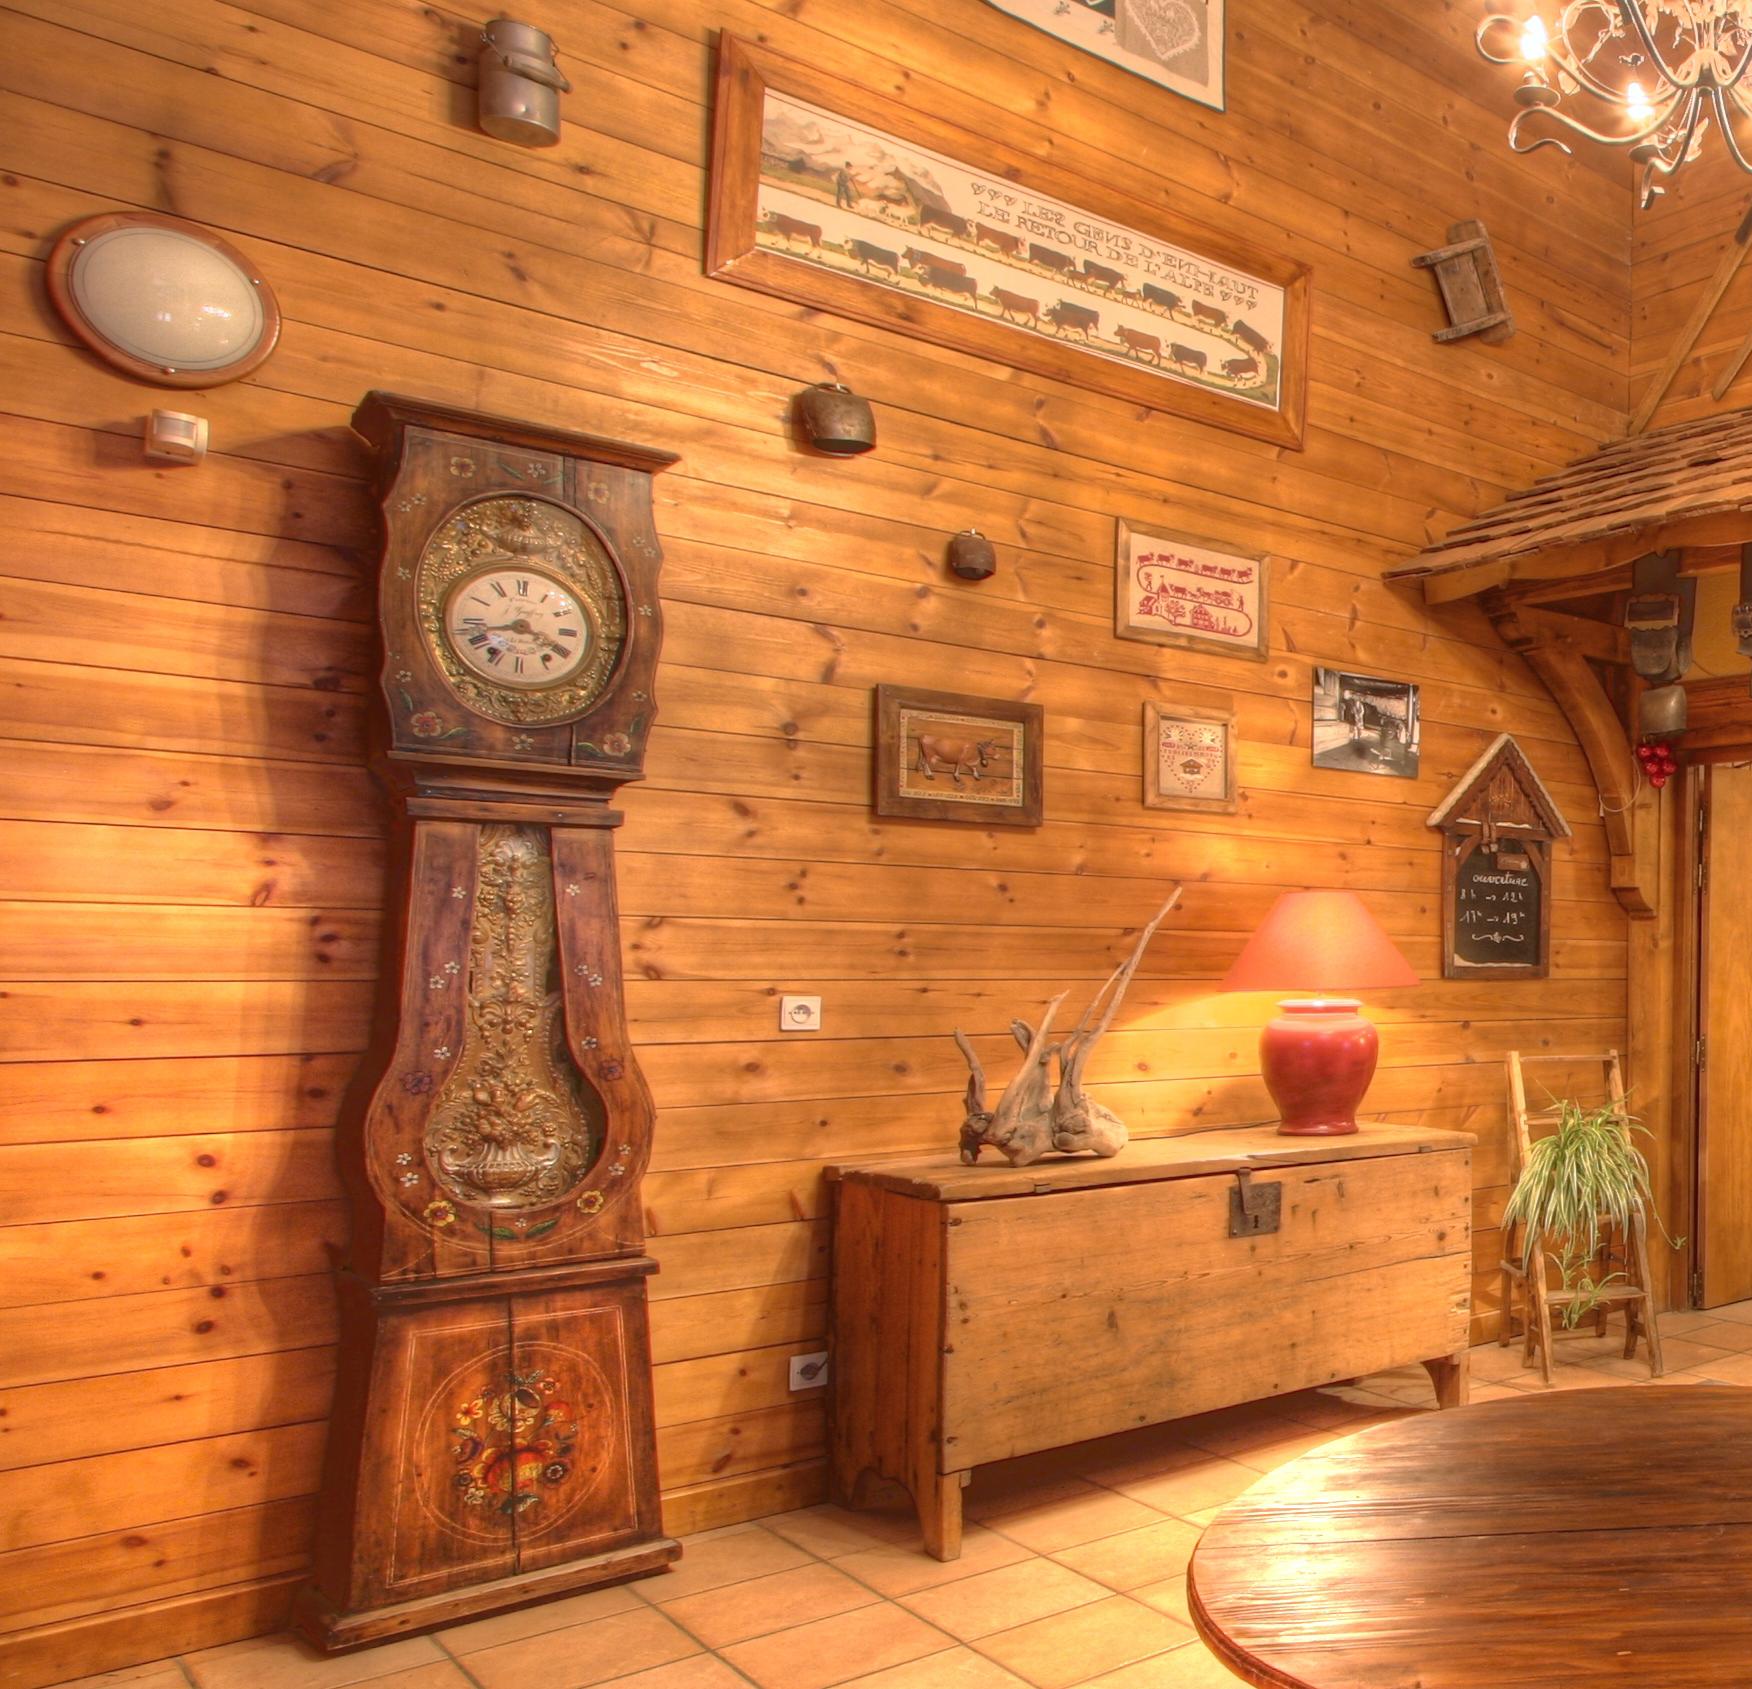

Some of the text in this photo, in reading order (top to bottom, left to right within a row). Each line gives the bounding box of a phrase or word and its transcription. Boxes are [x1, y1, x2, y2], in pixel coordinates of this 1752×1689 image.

[977, 200, 1010, 224] LE
[1016, 215, 1103, 257] RETOUR
[1105, 245, 1139, 269] DE
